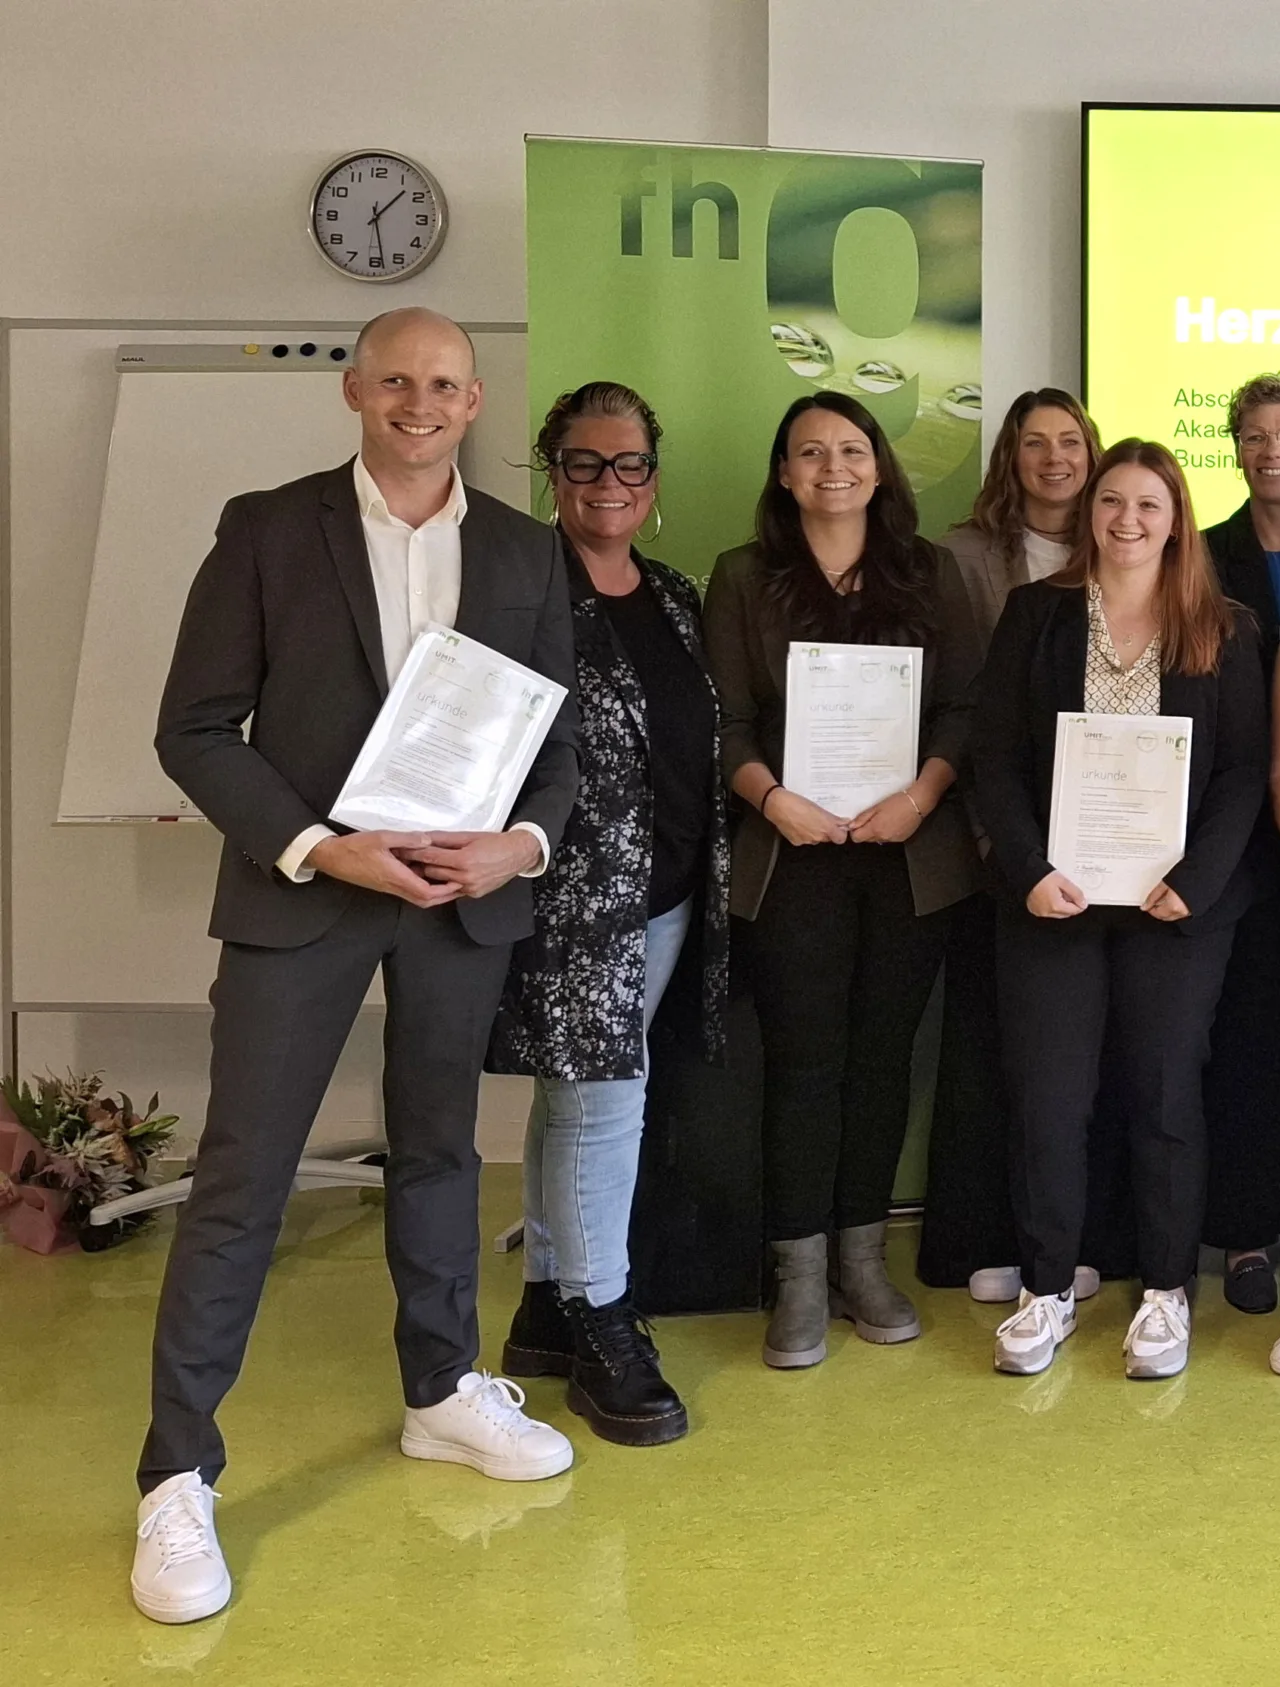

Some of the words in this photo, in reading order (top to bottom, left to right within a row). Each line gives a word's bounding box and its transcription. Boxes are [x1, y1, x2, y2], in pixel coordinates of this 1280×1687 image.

[351, 171, 362, 183] 11
[371, 167, 388, 178] 12
[332, 187, 348, 198] 10
[412, 192, 425, 203] 2
[326, 210, 338, 221] 9
[415, 214, 428, 226] 3
[330, 234, 343, 245] 8
[410, 236, 422, 248] 4
[346, 251, 358, 262] 7
[392, 253, 405, 264] 5
[369, 257, 381, 268] 6
[1175, 450, 1235, 468] Busin
[417, 691, 468, 720] urkunde
[1081, 769, 1127, 782] urkunde
